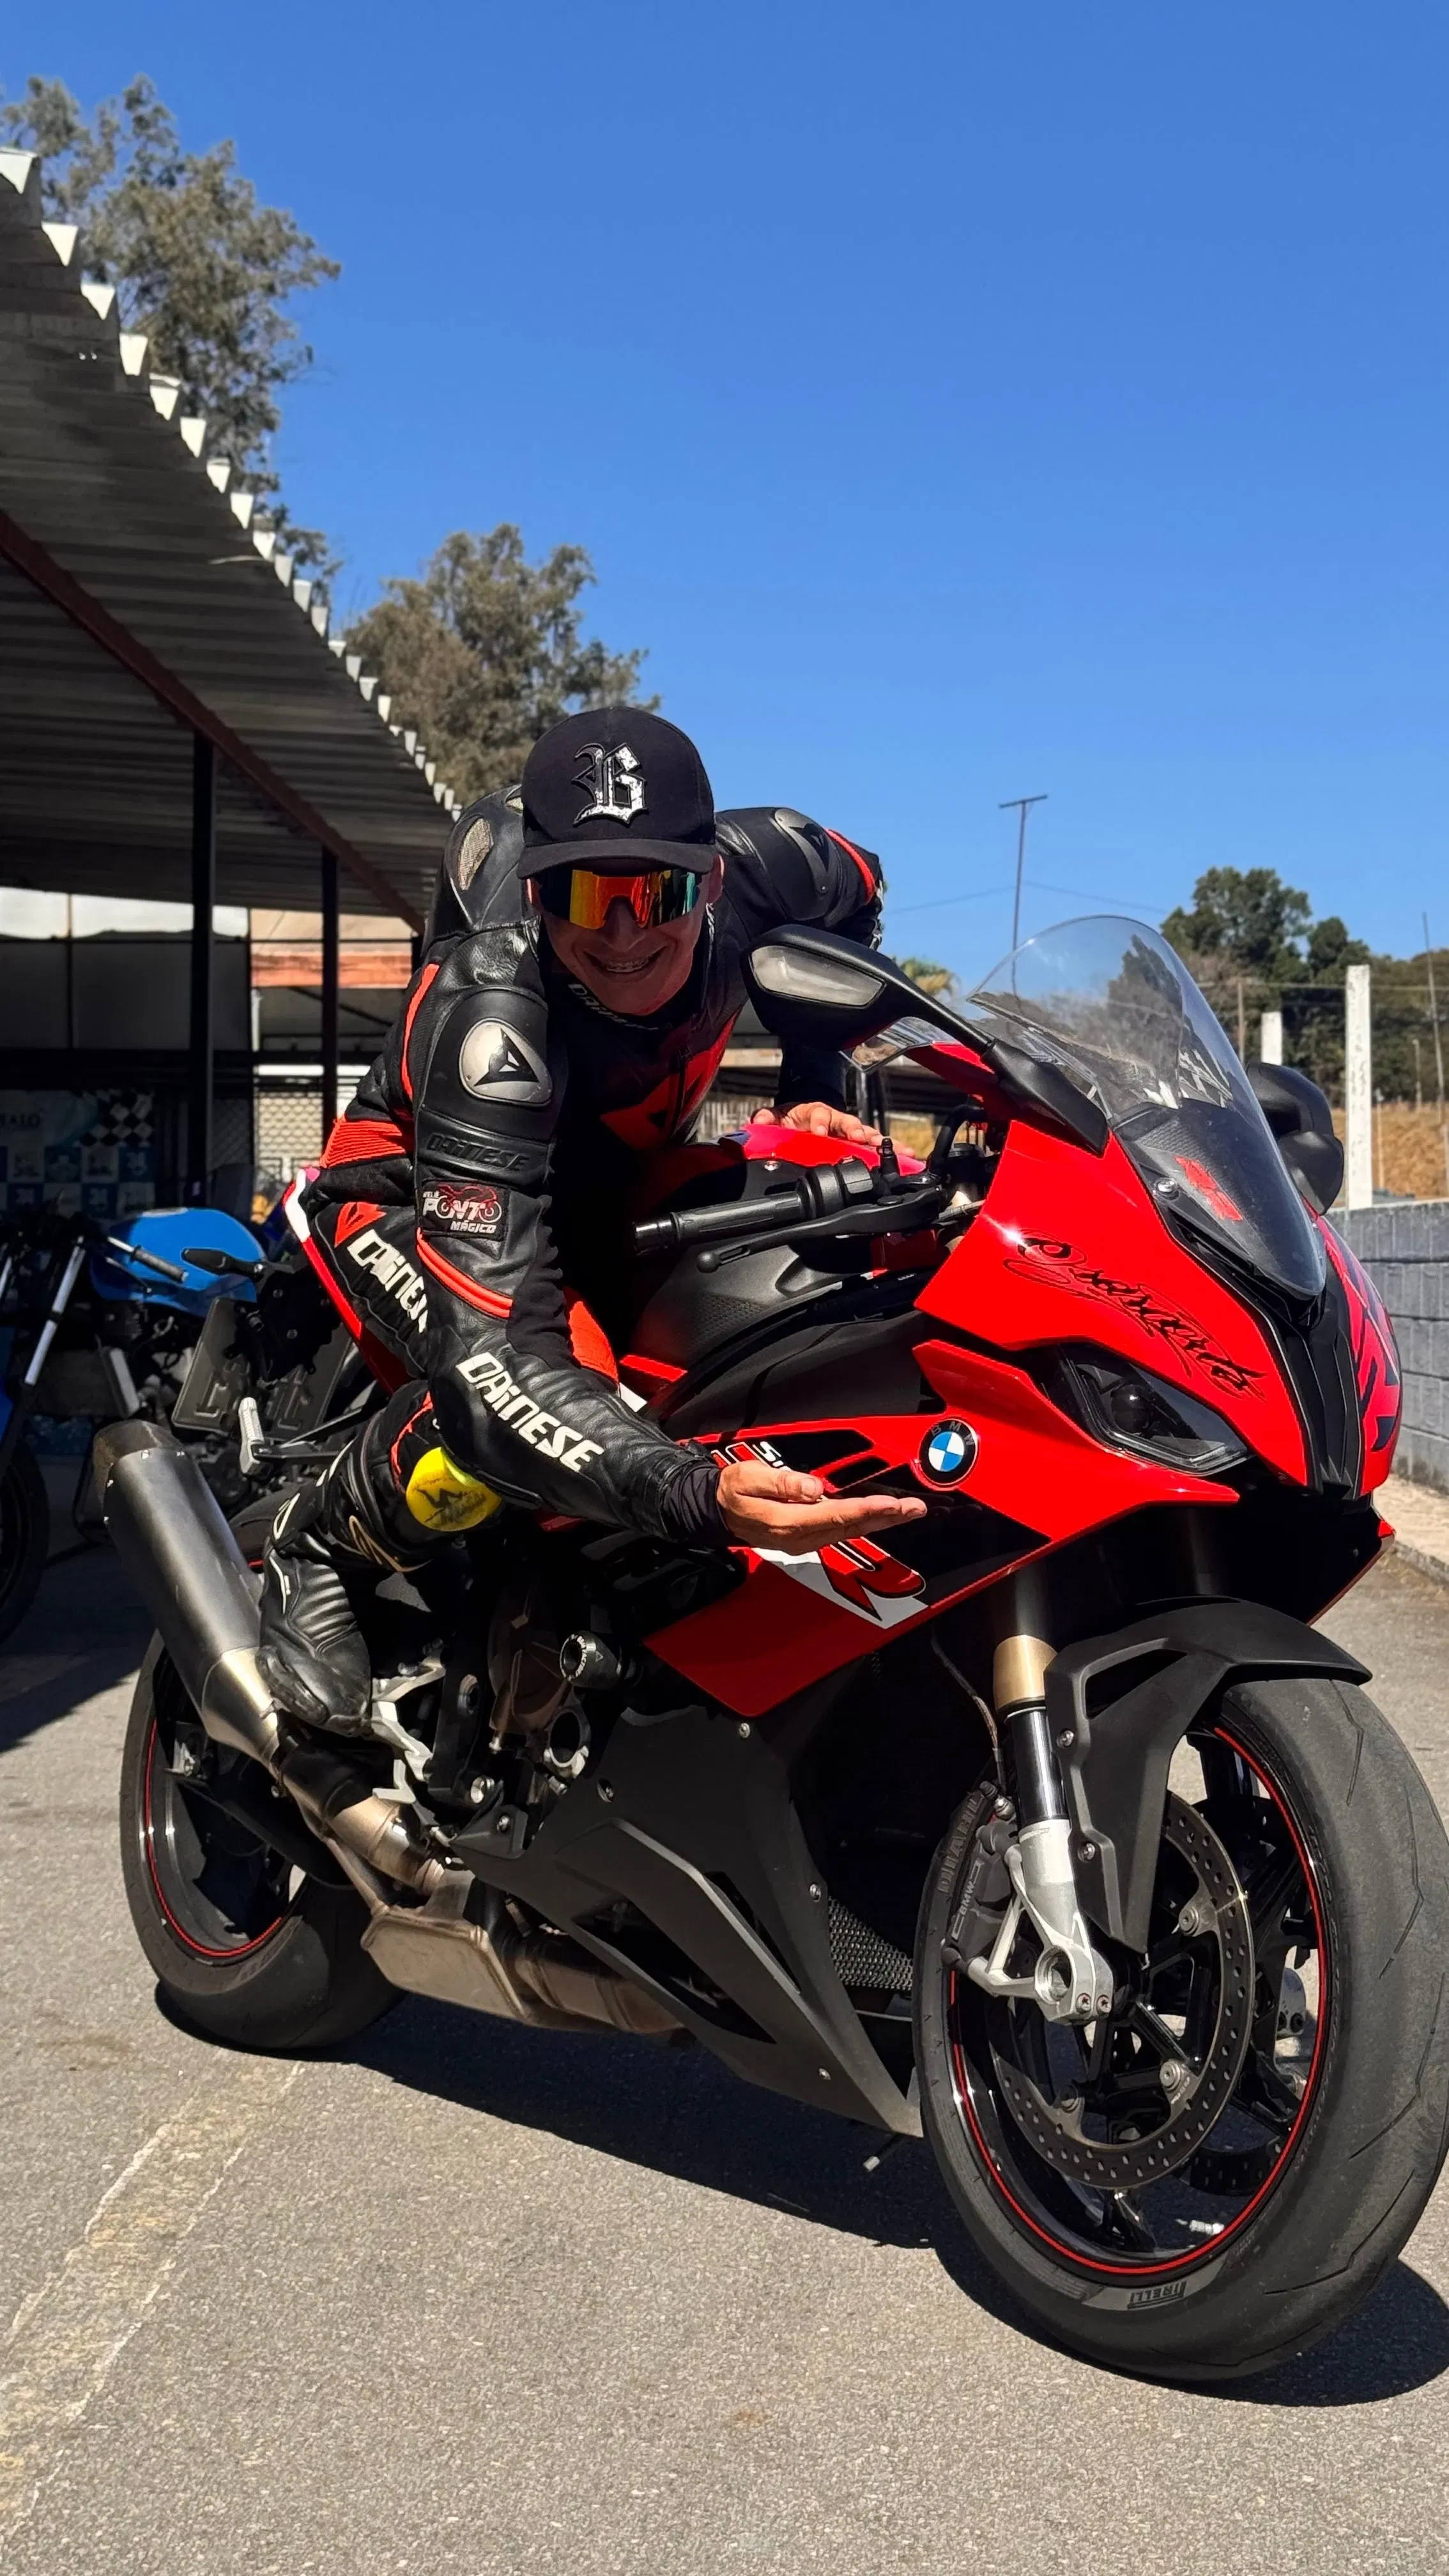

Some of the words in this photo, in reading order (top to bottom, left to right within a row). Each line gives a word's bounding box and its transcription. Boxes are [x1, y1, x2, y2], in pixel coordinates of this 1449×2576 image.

[456, 1353, 604, 1473] DAINESE
[930, 1420, 974, 1446] BMW
[939, 1793, 985, 1894] DIABL
[960, 1880, 975, 1915] BMW
[1127, 2281, 1187, 2309] PIRELLI
